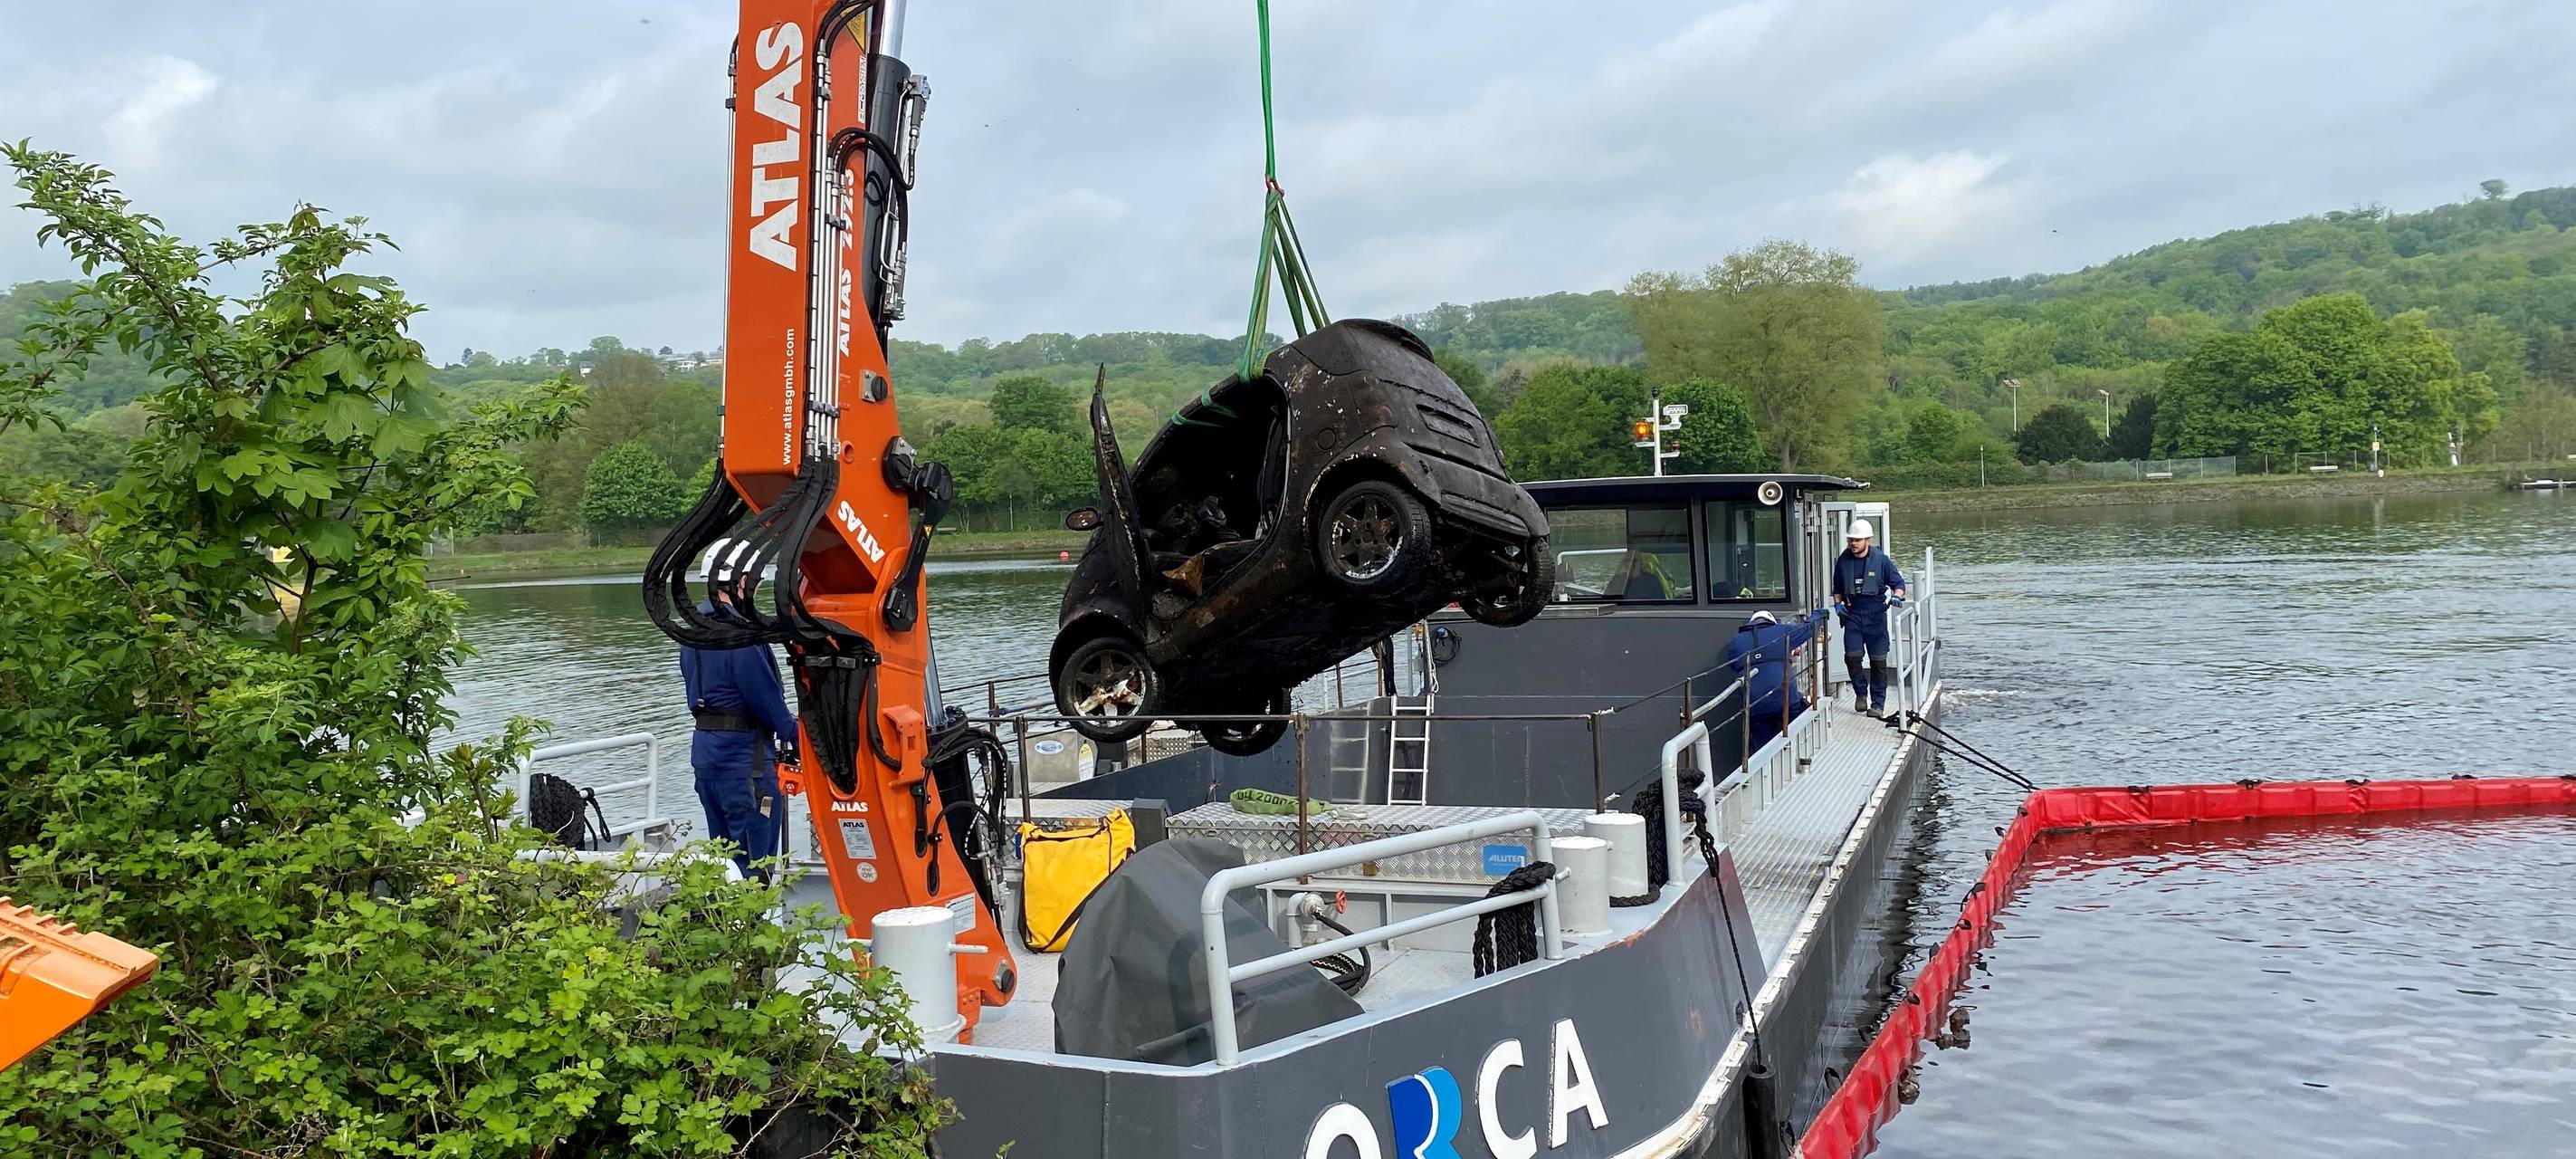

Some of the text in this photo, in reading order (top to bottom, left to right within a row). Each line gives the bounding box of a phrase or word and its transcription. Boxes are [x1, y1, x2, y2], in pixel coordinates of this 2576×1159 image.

[749, 22, 804, 272] ATLAS
[783, 329, 795, 465] www.atlasgmbh.com
[837, 500, 886, 563] ATLAS
[831, 800, 869, 812] ATLAS
